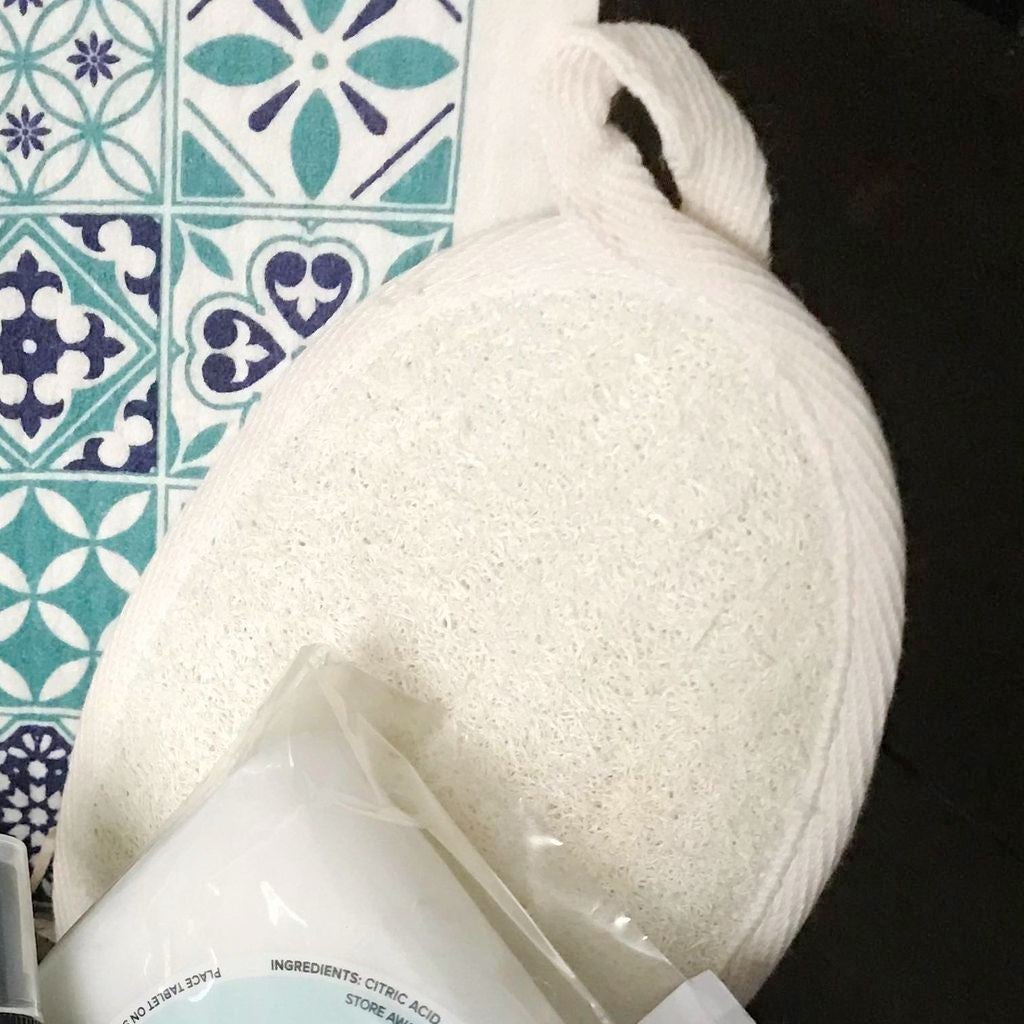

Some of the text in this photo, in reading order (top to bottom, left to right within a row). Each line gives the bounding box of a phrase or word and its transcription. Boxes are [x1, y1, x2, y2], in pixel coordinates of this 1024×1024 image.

[185, 967, 222, 989] PLACE
[271, 959, 362, 984] INGREDIENTS:
[365, 978, 408, 1005] CITRIC
[148, 983, 184, 1011] TABLET
[345, 993, 386, 1018] STORE
[130, 1006, 146, 1024] ON
